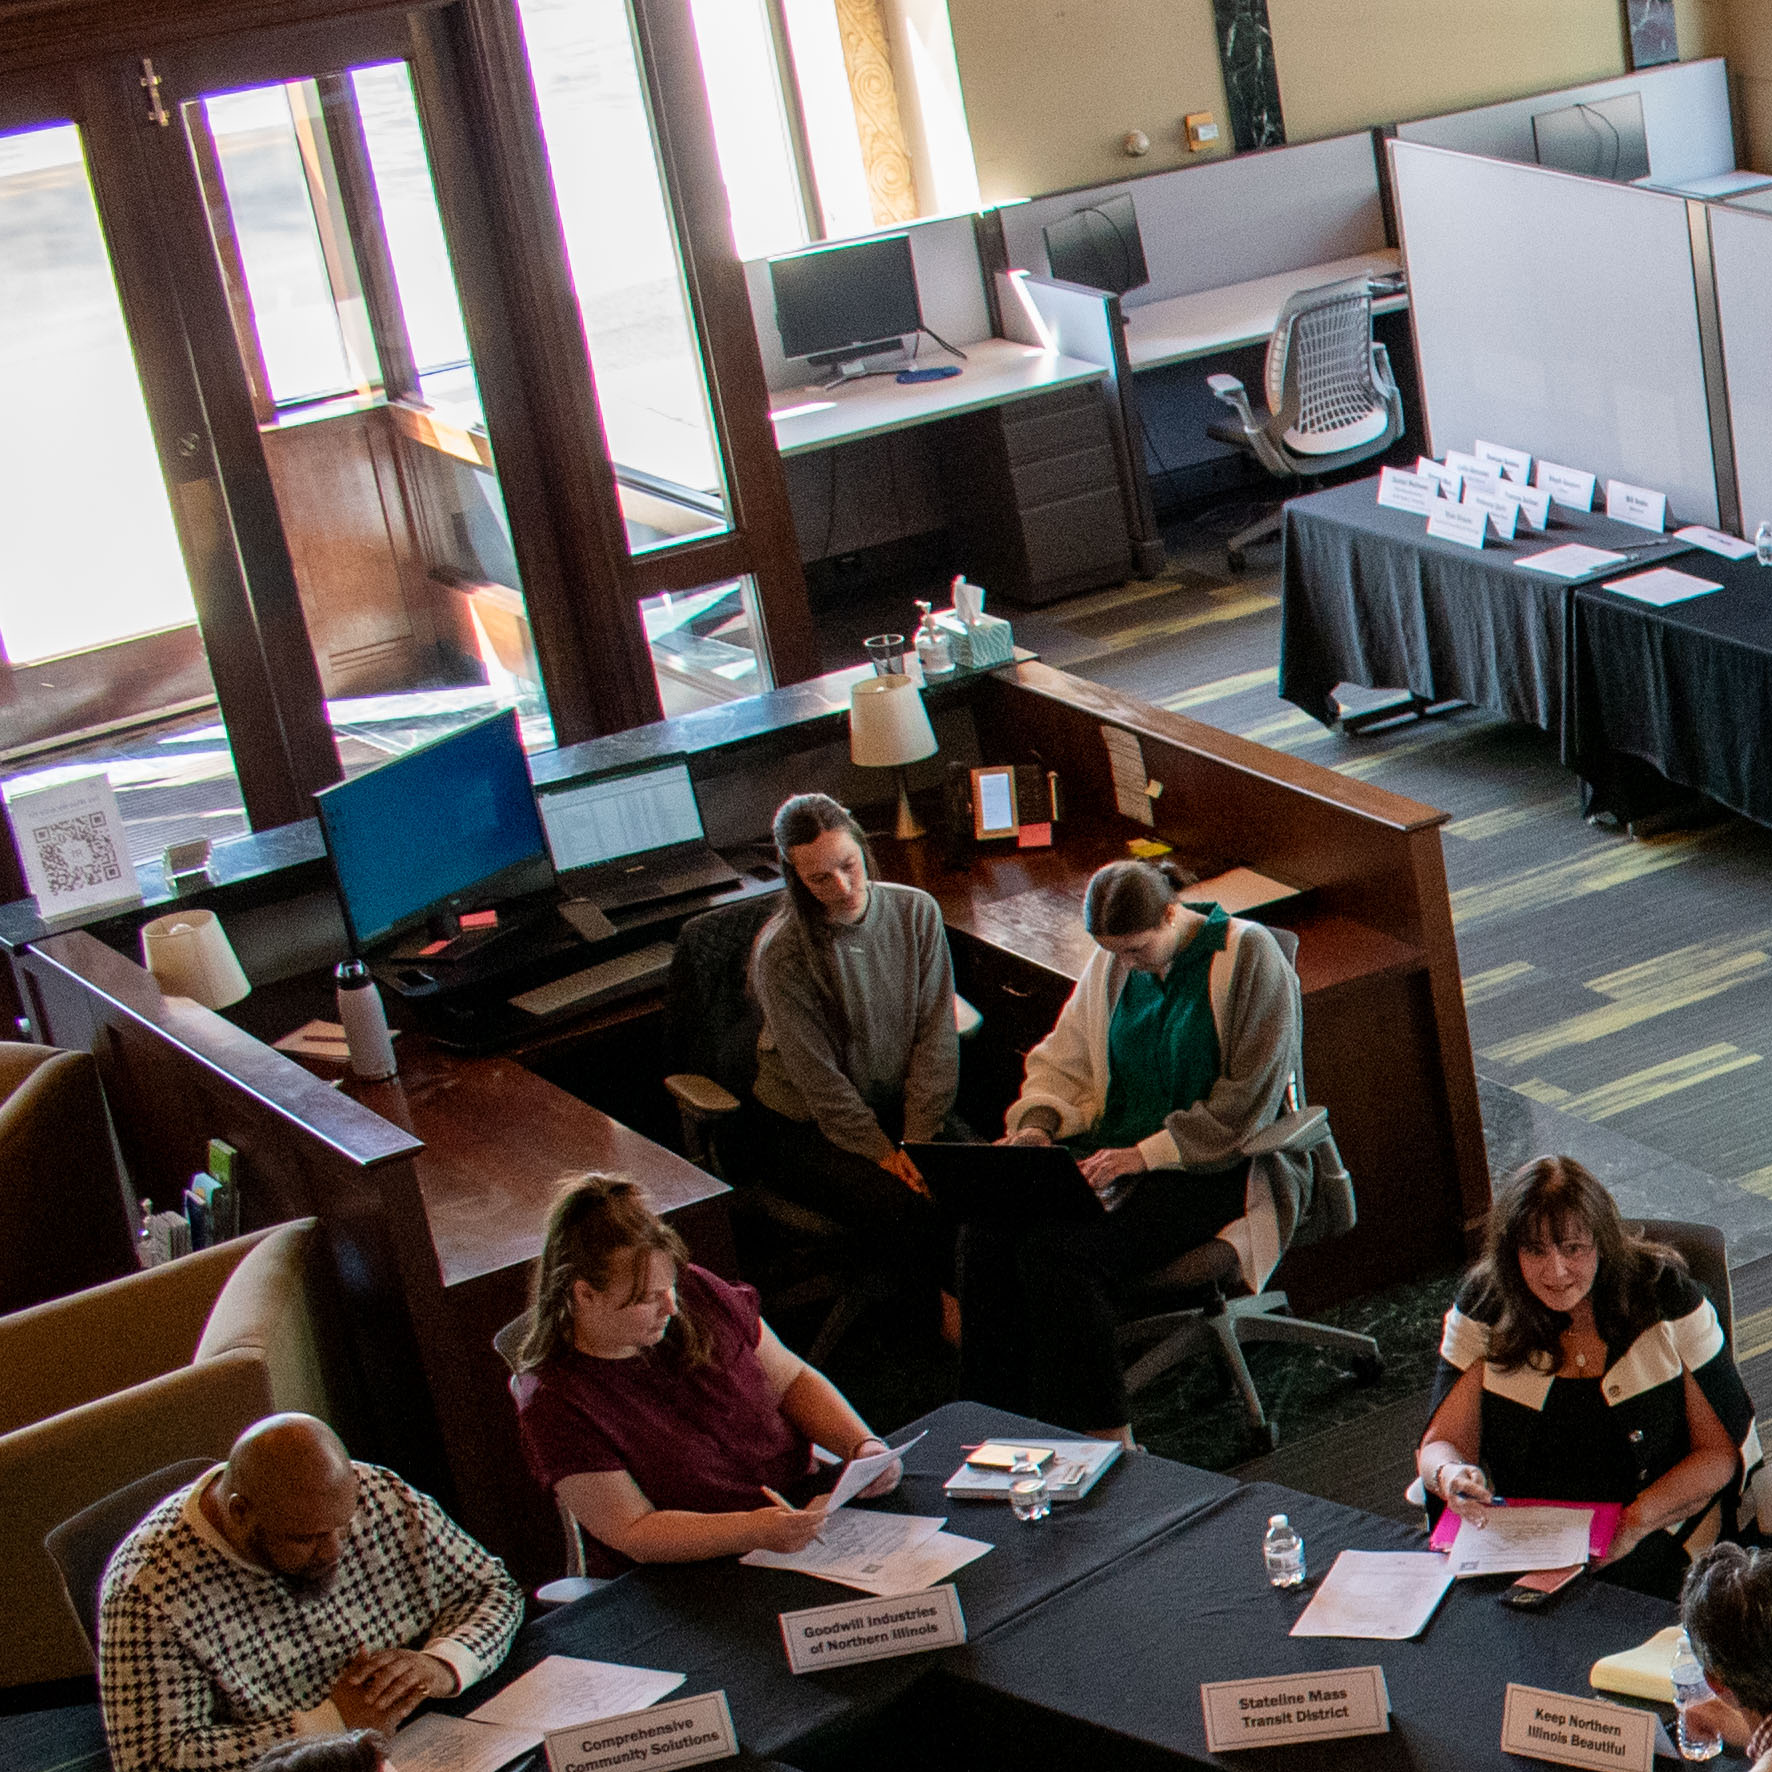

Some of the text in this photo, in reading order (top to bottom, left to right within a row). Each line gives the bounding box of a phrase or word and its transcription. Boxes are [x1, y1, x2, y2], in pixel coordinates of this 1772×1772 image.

[804, 1606, 938, 1638] Goodwill Industries
[810, 1622, 938, 1654] of Northern Illinois
[1239, 1689, 1348, 1710] Stateline Mass
[1241, 1705, 1349, 1729] Transit District
[1534, 1707, 1622, 1737] Keep Northern
[581, 1718, 693, 1753] Comprehensive
[650, 1731, 720, 1756] Solutions
[1527, 1724, 1626, 1757] Illinois Beautiful
